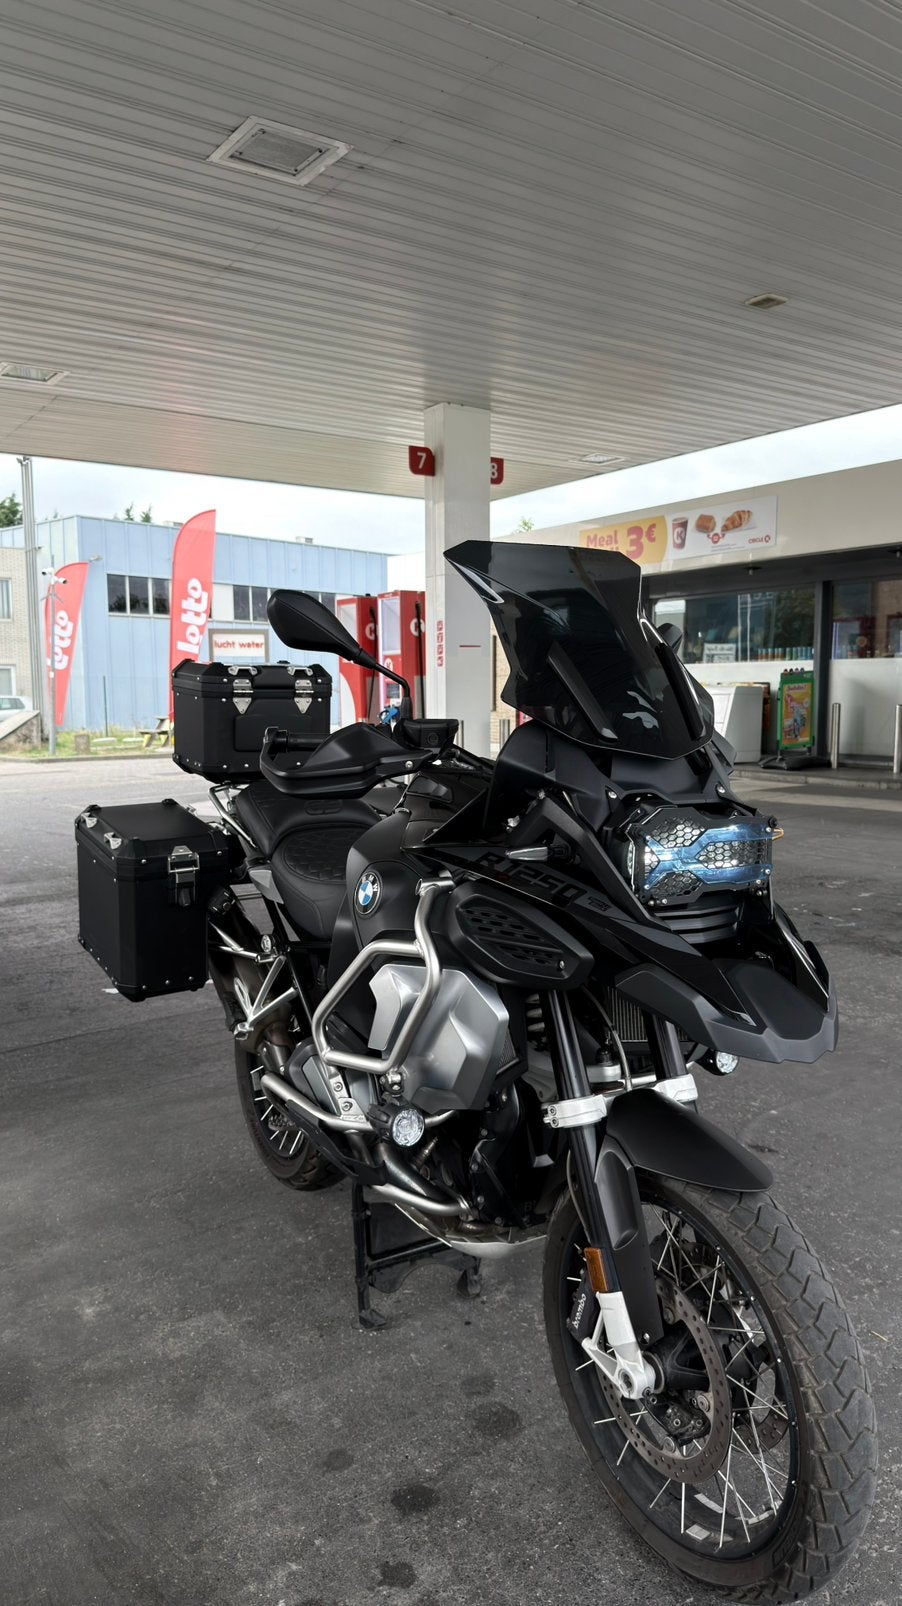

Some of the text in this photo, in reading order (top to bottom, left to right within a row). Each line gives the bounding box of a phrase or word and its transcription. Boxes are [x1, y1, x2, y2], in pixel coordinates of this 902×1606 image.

[417, 452, 427, 469] 7
[490, 463, 498, 479] 8
[586, 529, 618, 548] Meal
[176, 577, 208, 655] lotto
[214, 640, 264, 649] lucht water
[571, 1293, 587, 1329] brembo
